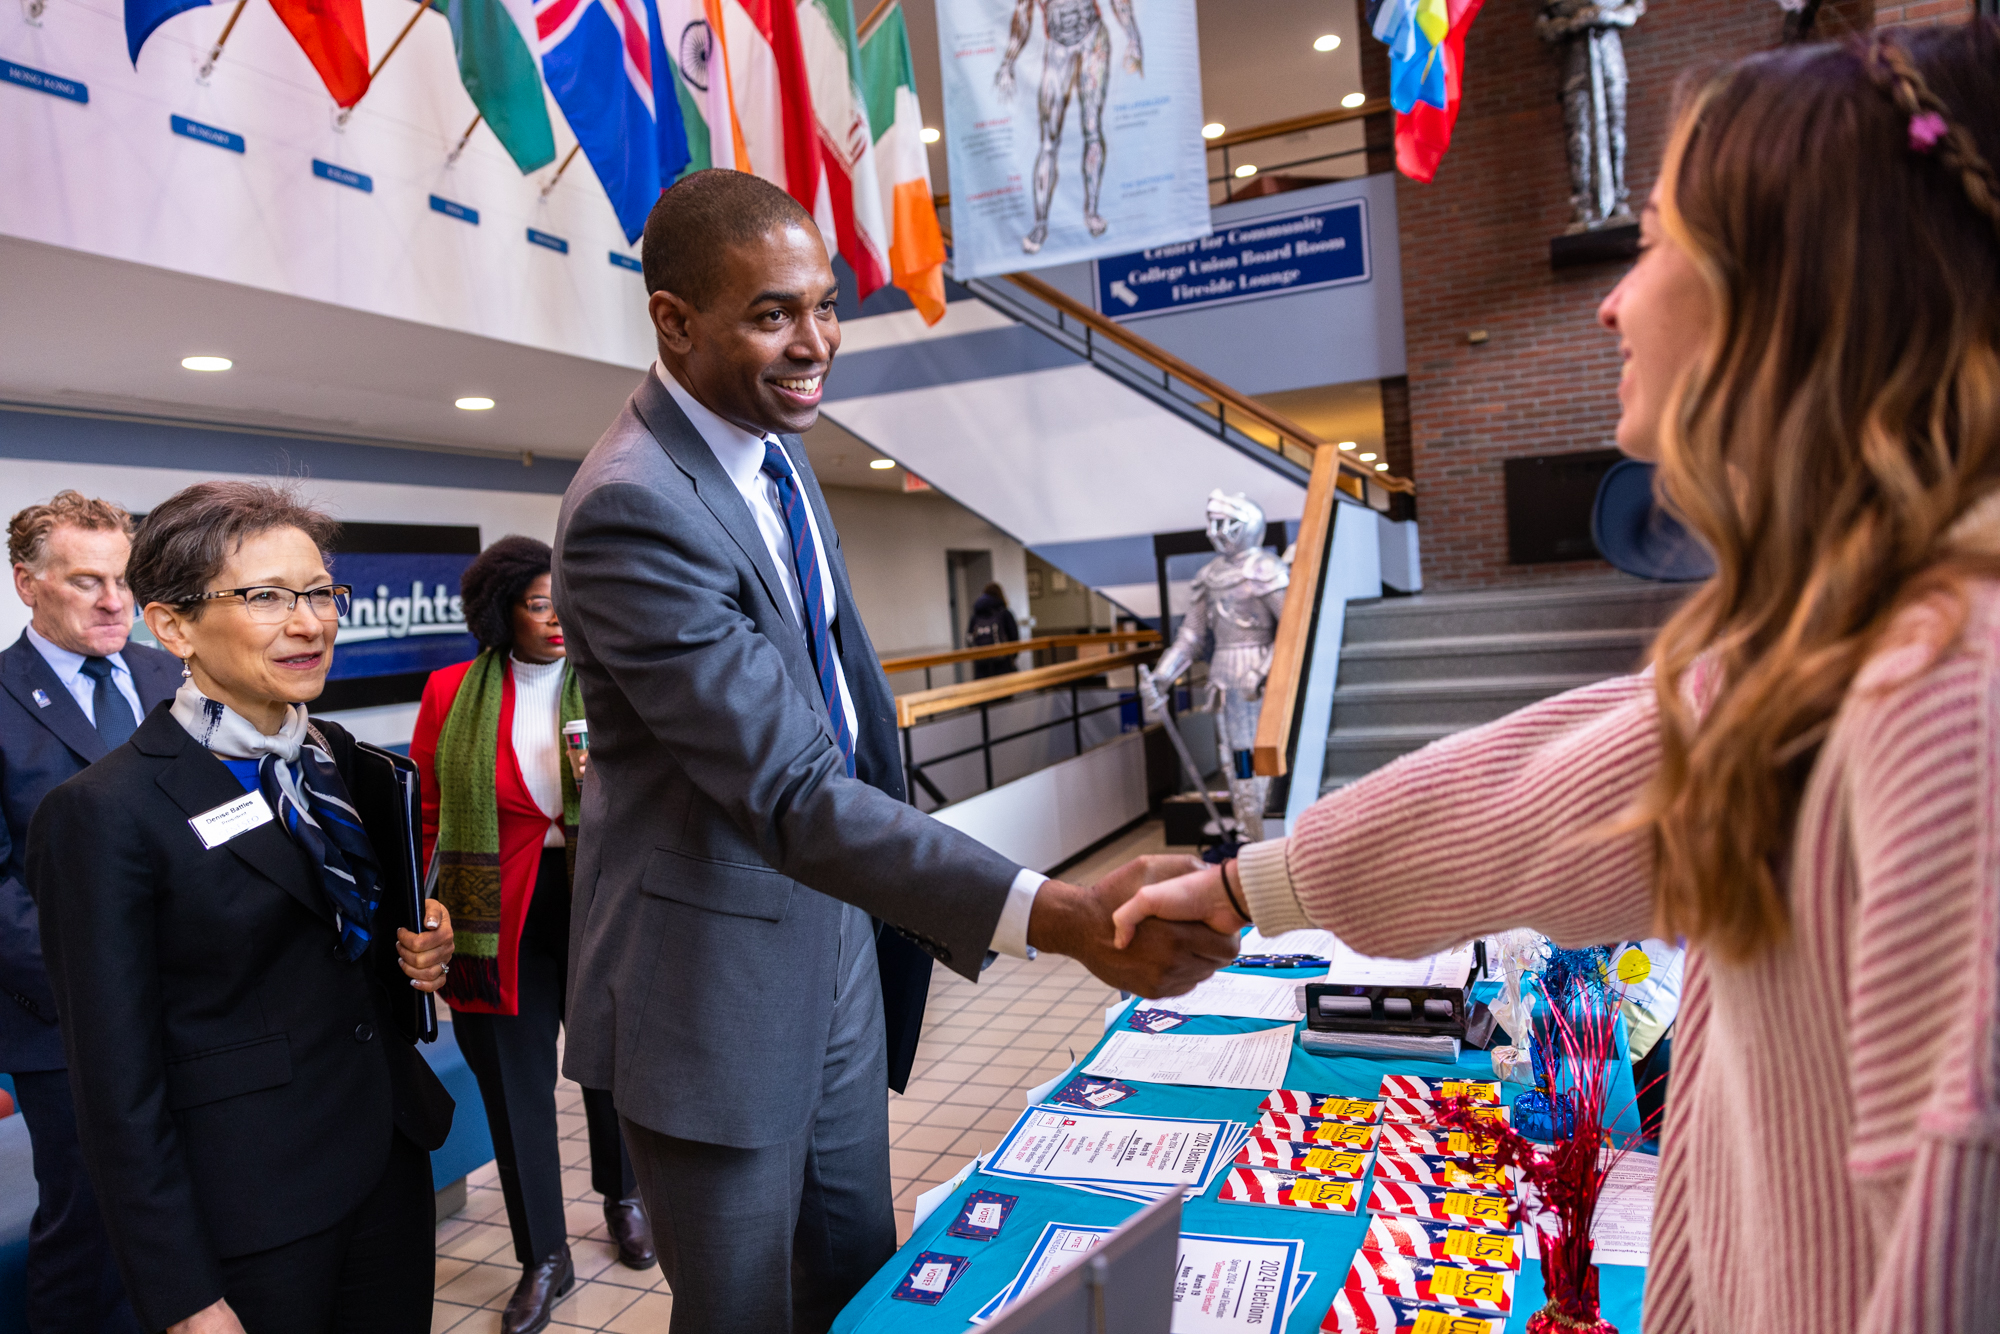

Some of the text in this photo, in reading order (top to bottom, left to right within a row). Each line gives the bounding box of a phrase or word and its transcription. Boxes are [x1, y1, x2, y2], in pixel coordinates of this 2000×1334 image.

[9, 66, 75, 95] HONG KONG
[1228, 216, 1325, 244] Community
[1128, 237, 1346, 286] College Union Board Room
[1172, 268, 1301, 300] Fireside Lounge
[206, 800, 254, 825] Denise Battles
[1343, 1102, 1369, 1114] U.S.
[1170, 1132, 1181, 1140] Spring
[1338, 1126, 1366, 1140] U.S.
[1141, 1142, 1152, 1151] March
[1182, 1132, 1212, 1172] 2024 Elections
[1328, 1154, 1357, 1169] U.S.
[1317, 1184, 1345, 1201] U.S.
[1472, 1198, 1500, 1216] U.S.
[978, 1208, 990, 1224] VOTE?
[1048, 1233, 1065, 1254] GENESEO
[1070, 1236, 1084, 1248] VOTE
[1475, 1236, 1504, 1256] U.S.
[1181, 1266, 1192, 1277] Noon
[1227, 1259, 1241, 1271] Spring
[922, 1268, 938, 1286] VOTE?
[1193, 1274, 1205, 1288] March
[1226, 1272, 1237, 1284] 2024
[1463, 1274, 1494, 1296] U.S.
[1175, 1282, 1187, 1293] 9:00
[1201, 1260, 1225, 1314] "Genesee Village Election"
[1221, 1287, 1232, 1298] Local
[1247, 1260, 1279, 1323] 2024 Elections
[1216, 1299, 1229, 1317] Election:
